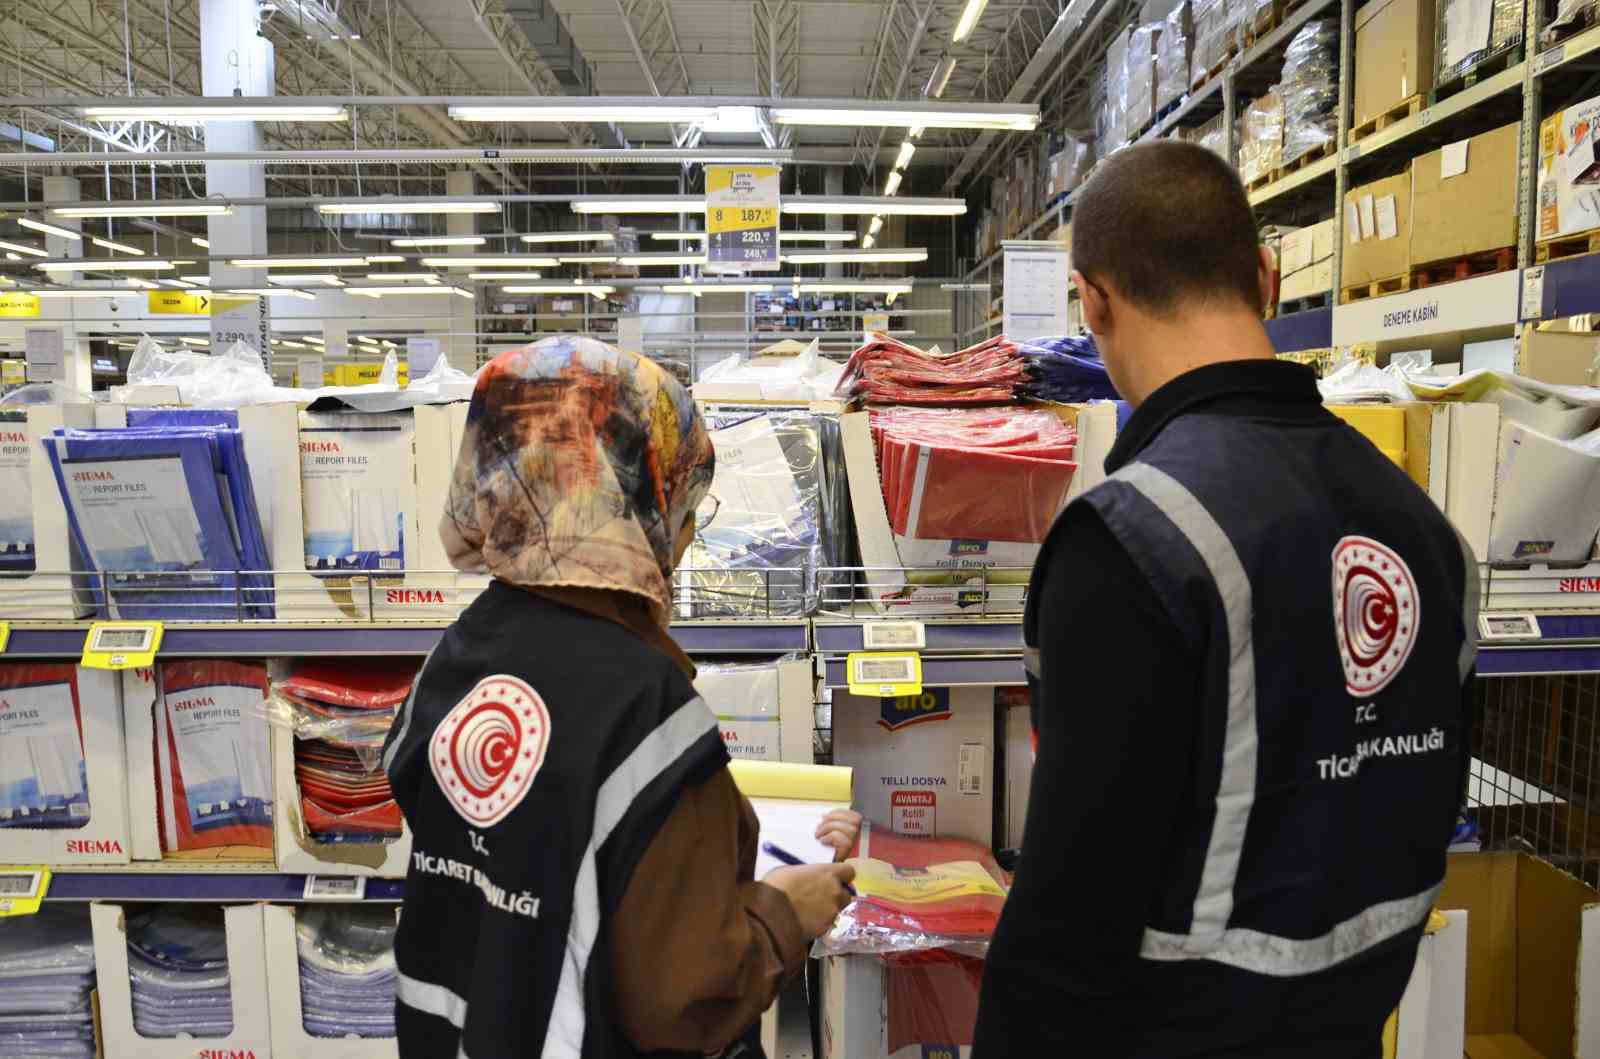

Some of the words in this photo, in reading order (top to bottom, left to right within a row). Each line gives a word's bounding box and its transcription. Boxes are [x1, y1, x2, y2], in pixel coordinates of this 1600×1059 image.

[1383, 309, 1412, 328] DENEME
[1412, 300, 1439, 322] KABİNİ
[315, 455, 345, 465] REPORT
[347, 455, 369, 465] FILES
[72, 471, 115, 481] SIGMA
[94, 484, 122, 494] REPORT
[124, 483, 147, 492] FILES
[1559, 577, 1600, 593] SIGM
[386, 589, 444, 604] SIGMA
[174, 697, 215, 711] SIGMA
[880, 775, 909, 786] TELLİ
[911, 776, 947, 786] DOSYA
[895, 795, 933, 804] AVANTAJ
[66, 839, 123, 855] SIGMA
[413, 850, 473, 883] TİCARET
